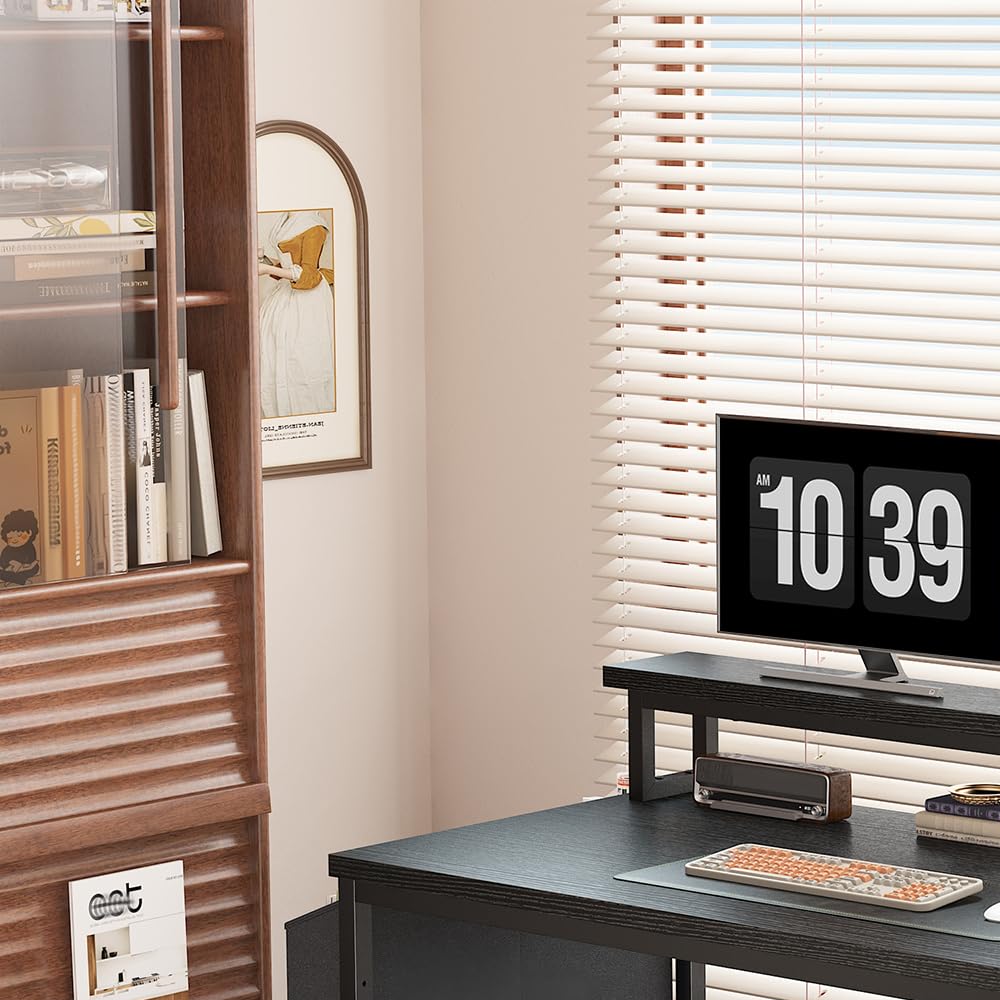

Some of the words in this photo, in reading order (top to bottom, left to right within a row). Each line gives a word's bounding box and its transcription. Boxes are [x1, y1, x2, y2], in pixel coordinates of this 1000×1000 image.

[756, 473, 771, 487] AM
[760, 476, 844, 591] 10
[868, 484, 964, 603] 39
